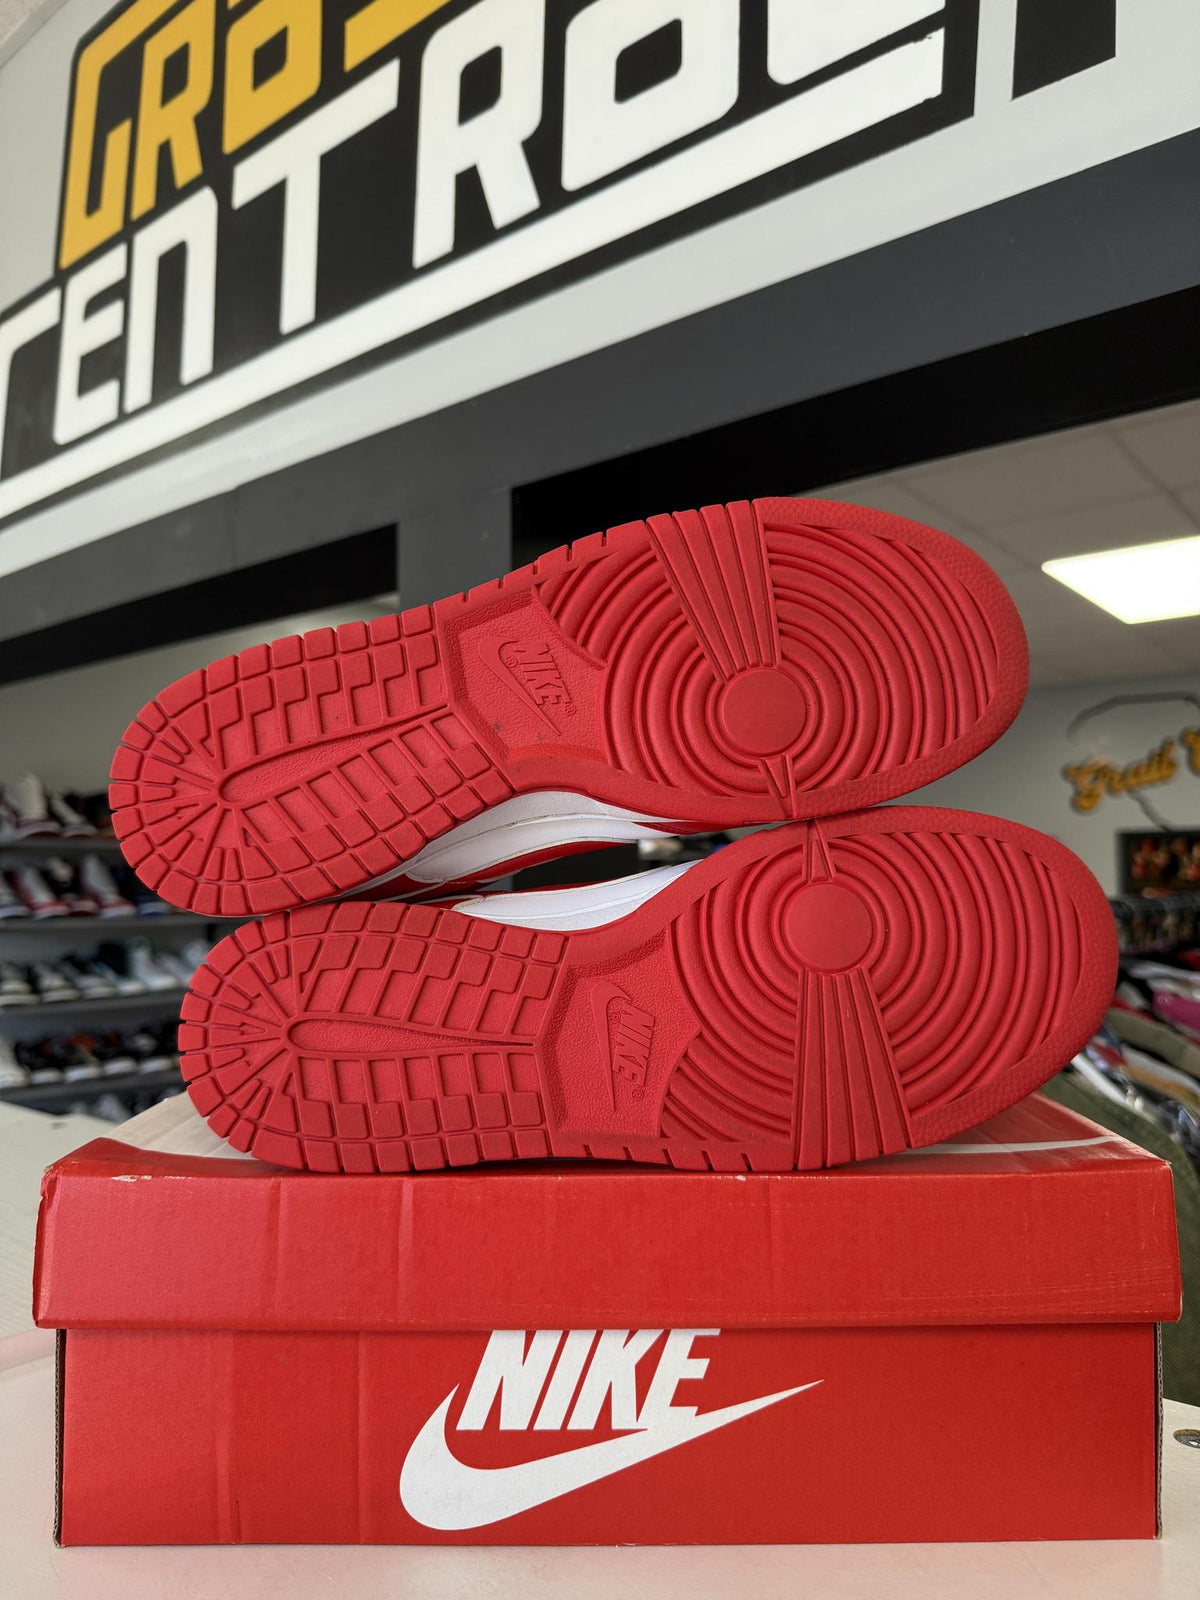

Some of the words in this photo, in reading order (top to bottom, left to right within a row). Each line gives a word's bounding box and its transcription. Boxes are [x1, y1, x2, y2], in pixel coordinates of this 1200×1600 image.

[512, 640, 573, 706] NIKE
[612, 1001, 656, 1088] NIKE
[456, 1328, 721, 1431] NIKE
